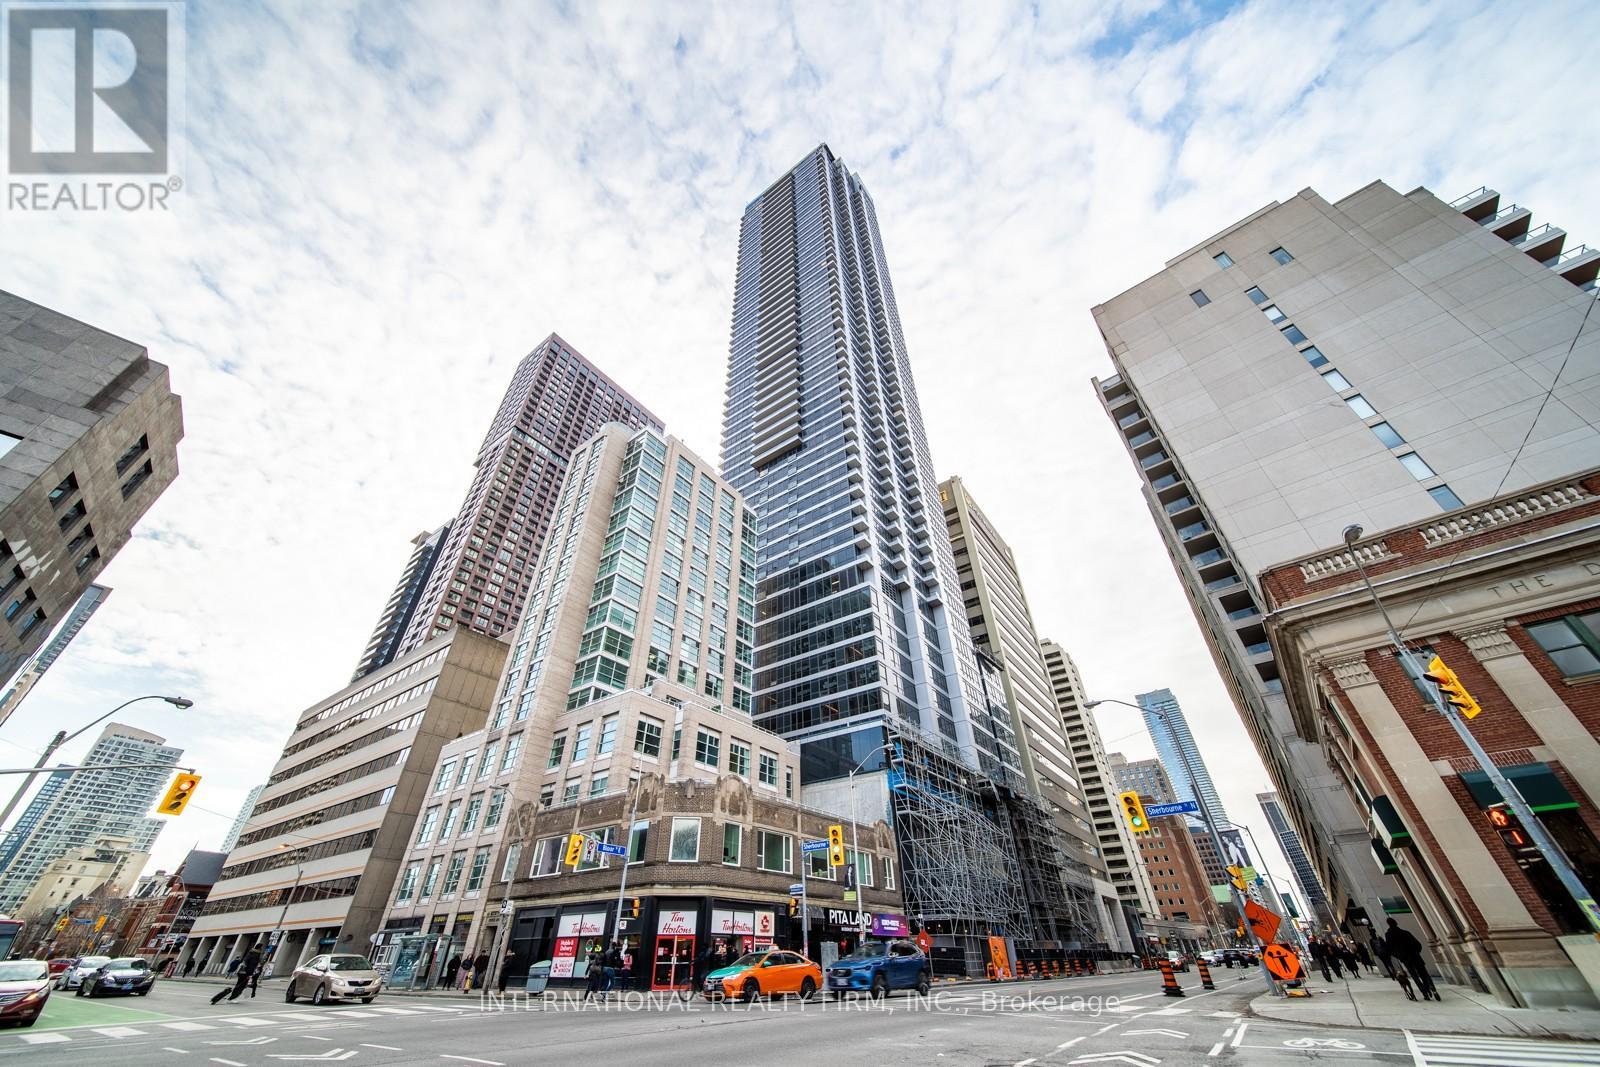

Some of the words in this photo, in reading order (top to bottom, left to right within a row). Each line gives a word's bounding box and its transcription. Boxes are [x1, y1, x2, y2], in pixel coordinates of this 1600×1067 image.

[1487, 574, 1554, 599] THE
[1148, 805, 1183, 815] Sherbourne
[1189, 802, 1197, 810] N
[602, 844, 615, 852] Bloor
[803, 842, 826, 850] Sherbourne
[671, 911, 685, 922] Tim
[829, 909, 849, 924] PITA
[849, 910, 872, 926] LAND
[662, 922, 692, 934] Hortons
[722, 919, 733, 931] Tim
[733, 920, 753, 932] Hortons
